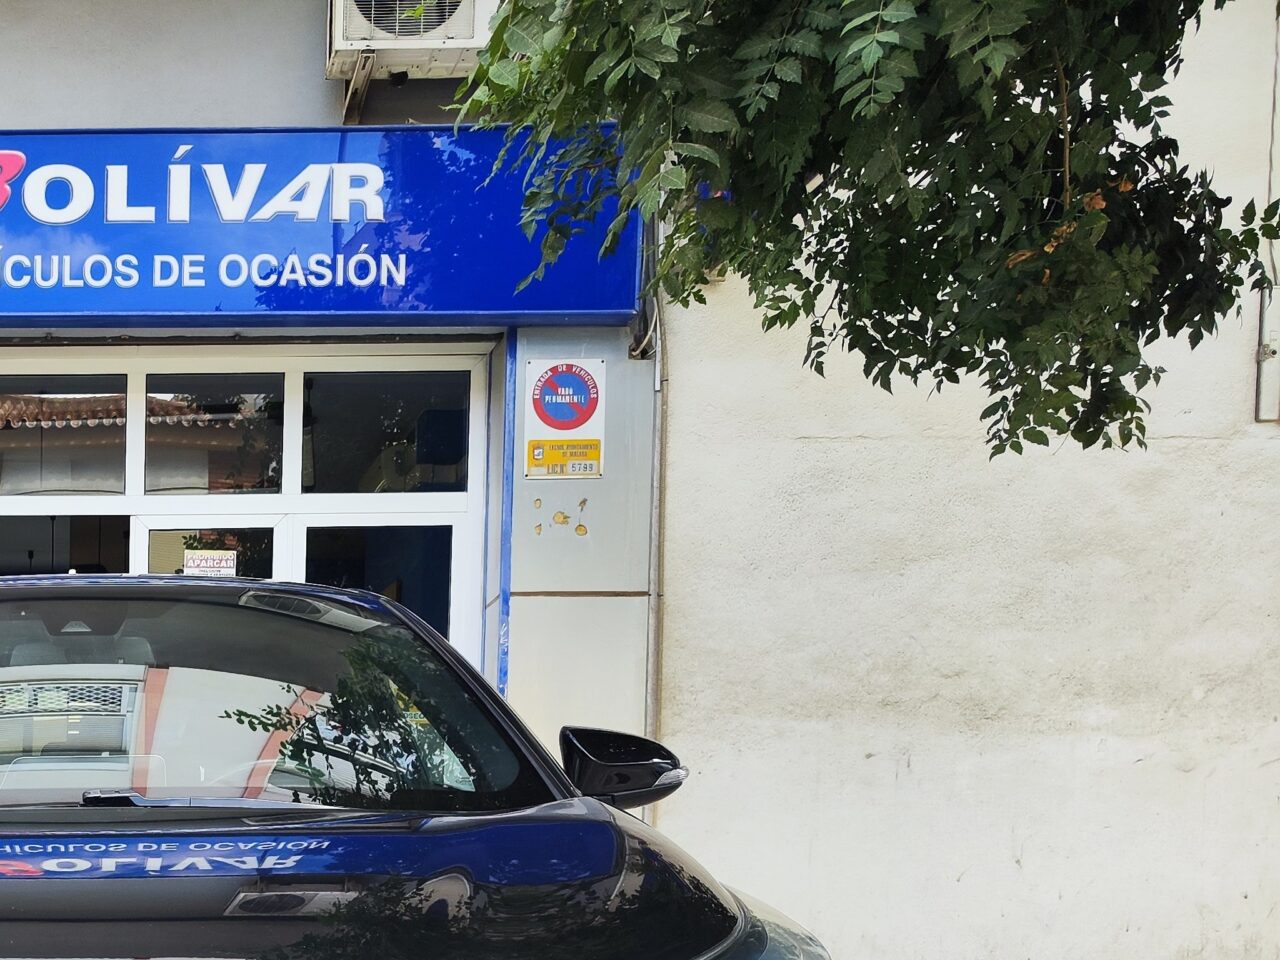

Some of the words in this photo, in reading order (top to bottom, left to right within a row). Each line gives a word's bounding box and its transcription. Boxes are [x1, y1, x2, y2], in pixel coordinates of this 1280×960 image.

[152, 255, 207, 287] DE
[218, 244, 407, 288] OCASIÓN
[186, 560, 234, 568] APARCAR
